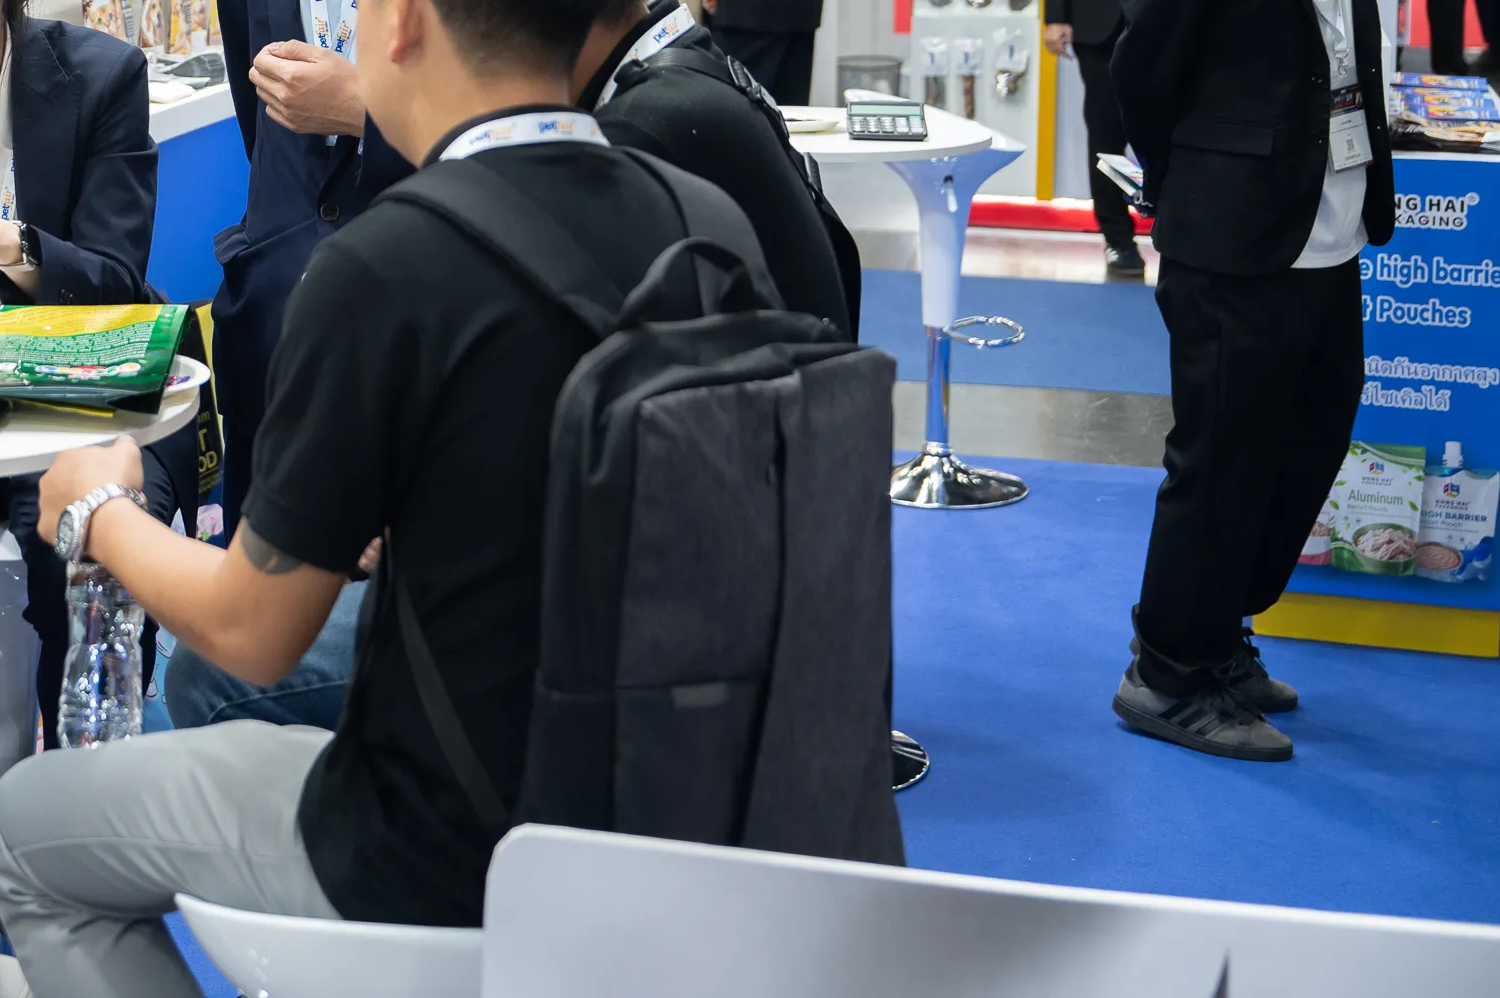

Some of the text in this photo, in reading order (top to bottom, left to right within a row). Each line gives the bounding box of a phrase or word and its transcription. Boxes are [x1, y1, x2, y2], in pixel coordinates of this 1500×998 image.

[1394, 196, 1466, 214] NG HAI
[1395, 214, 1465, 228] KAGING
[1377, 253, 1428, 288] high
[1432, 256, 1500, 288] barrie
[1376, 295, 1471, 328] Pouches
[1364, 355, 1500, 389] นิดกันอากาศสูง
[1348, 489, 1404, 506] Aluminum
[1445, 512, 1488, 524] BARRIER
